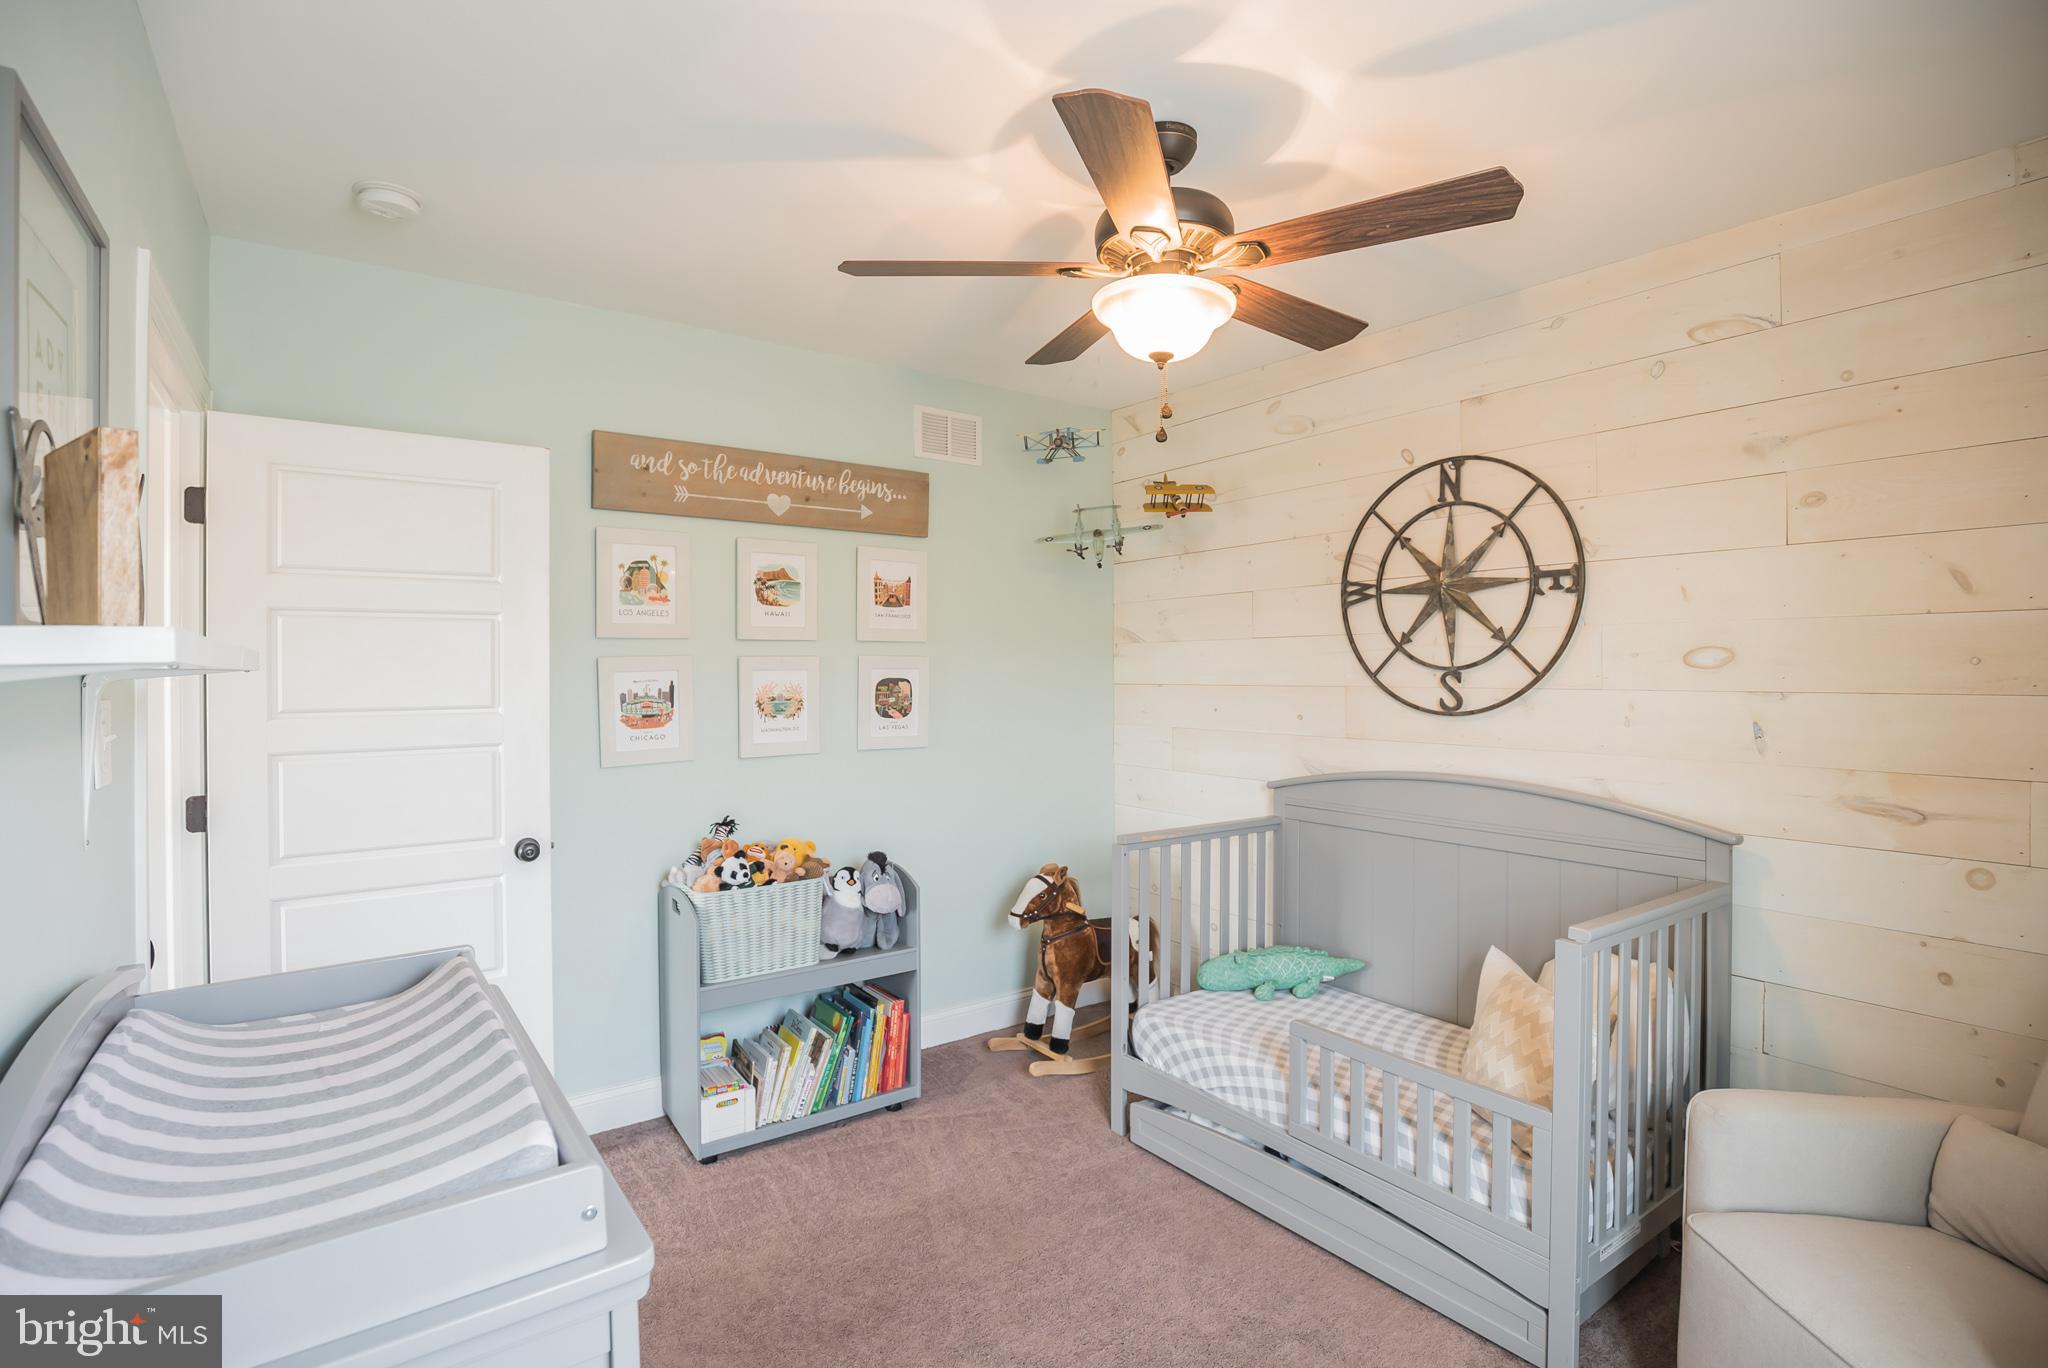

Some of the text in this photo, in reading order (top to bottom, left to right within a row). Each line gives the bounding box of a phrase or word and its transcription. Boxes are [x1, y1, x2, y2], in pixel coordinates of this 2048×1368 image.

[630, 451, 907, 502] and so the adventure begins...
[1438, 459, 1464, 502] N
[1344, 580, 1378, 608] W
[1533, 563, 1580, 596] E
[618, 608, 670, 617] LOS ANGELES
[1440, 671, 1463, 711] S
[629, 733, 666, 741] CHICAGO
